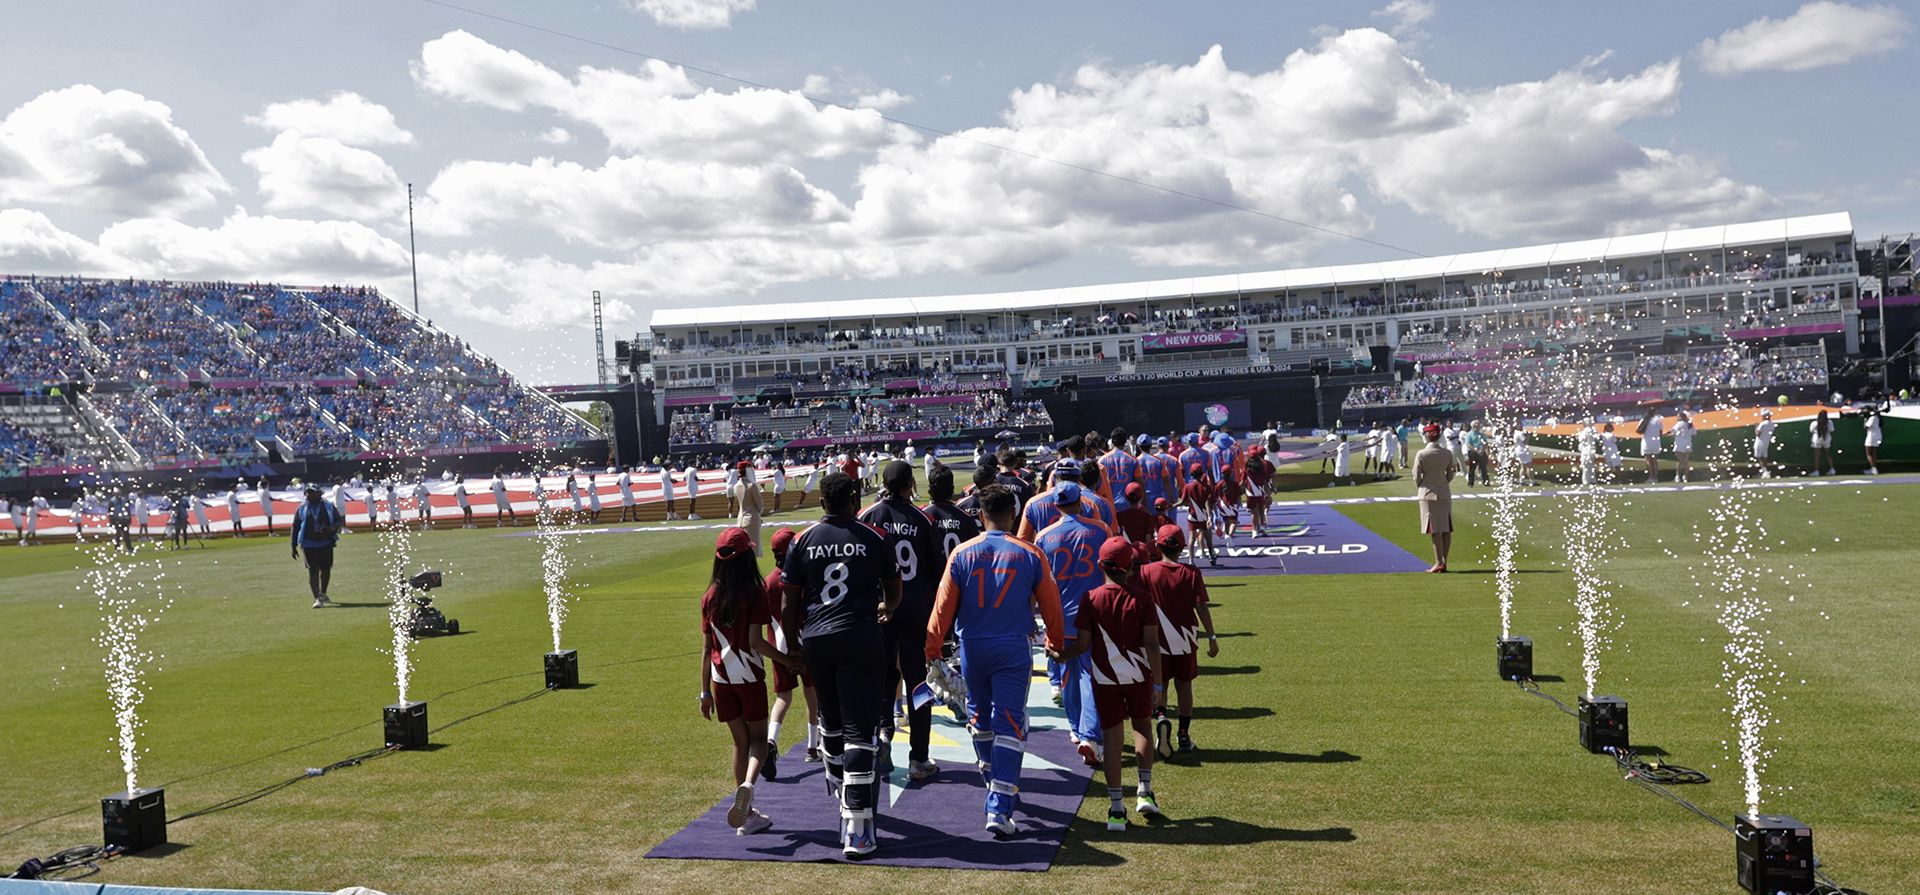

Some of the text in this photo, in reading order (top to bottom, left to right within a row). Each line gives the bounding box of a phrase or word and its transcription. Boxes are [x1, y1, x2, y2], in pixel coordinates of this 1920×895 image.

[1166, 333, 1222, 346] NEW YORK
[1157, 371, 1184, 379] WORLD
[1202, 368, 1223, 376] WEST
[1224, 367, 1249, 375] INDIES
[1256, 365, 1272, 373] USA
[1274, 364, 1291, 372] 2024
[930, 381, 1001, 391] OUT OF THIS WORLD
[429, 448, 442, 456] OUT
[443, 447, 452, 455] OF
[882, 522, 918, 537] SINGH
[937, 518, 961, 530] ANGIR
[806, 543, 867, 560] TAYLOR
[1226, 543, 1369, 557] WORLD
[1053, 543, 1095, 581] 23
[820, 562, 849, 606] 8
[971, 567, 1017, 609] 17
